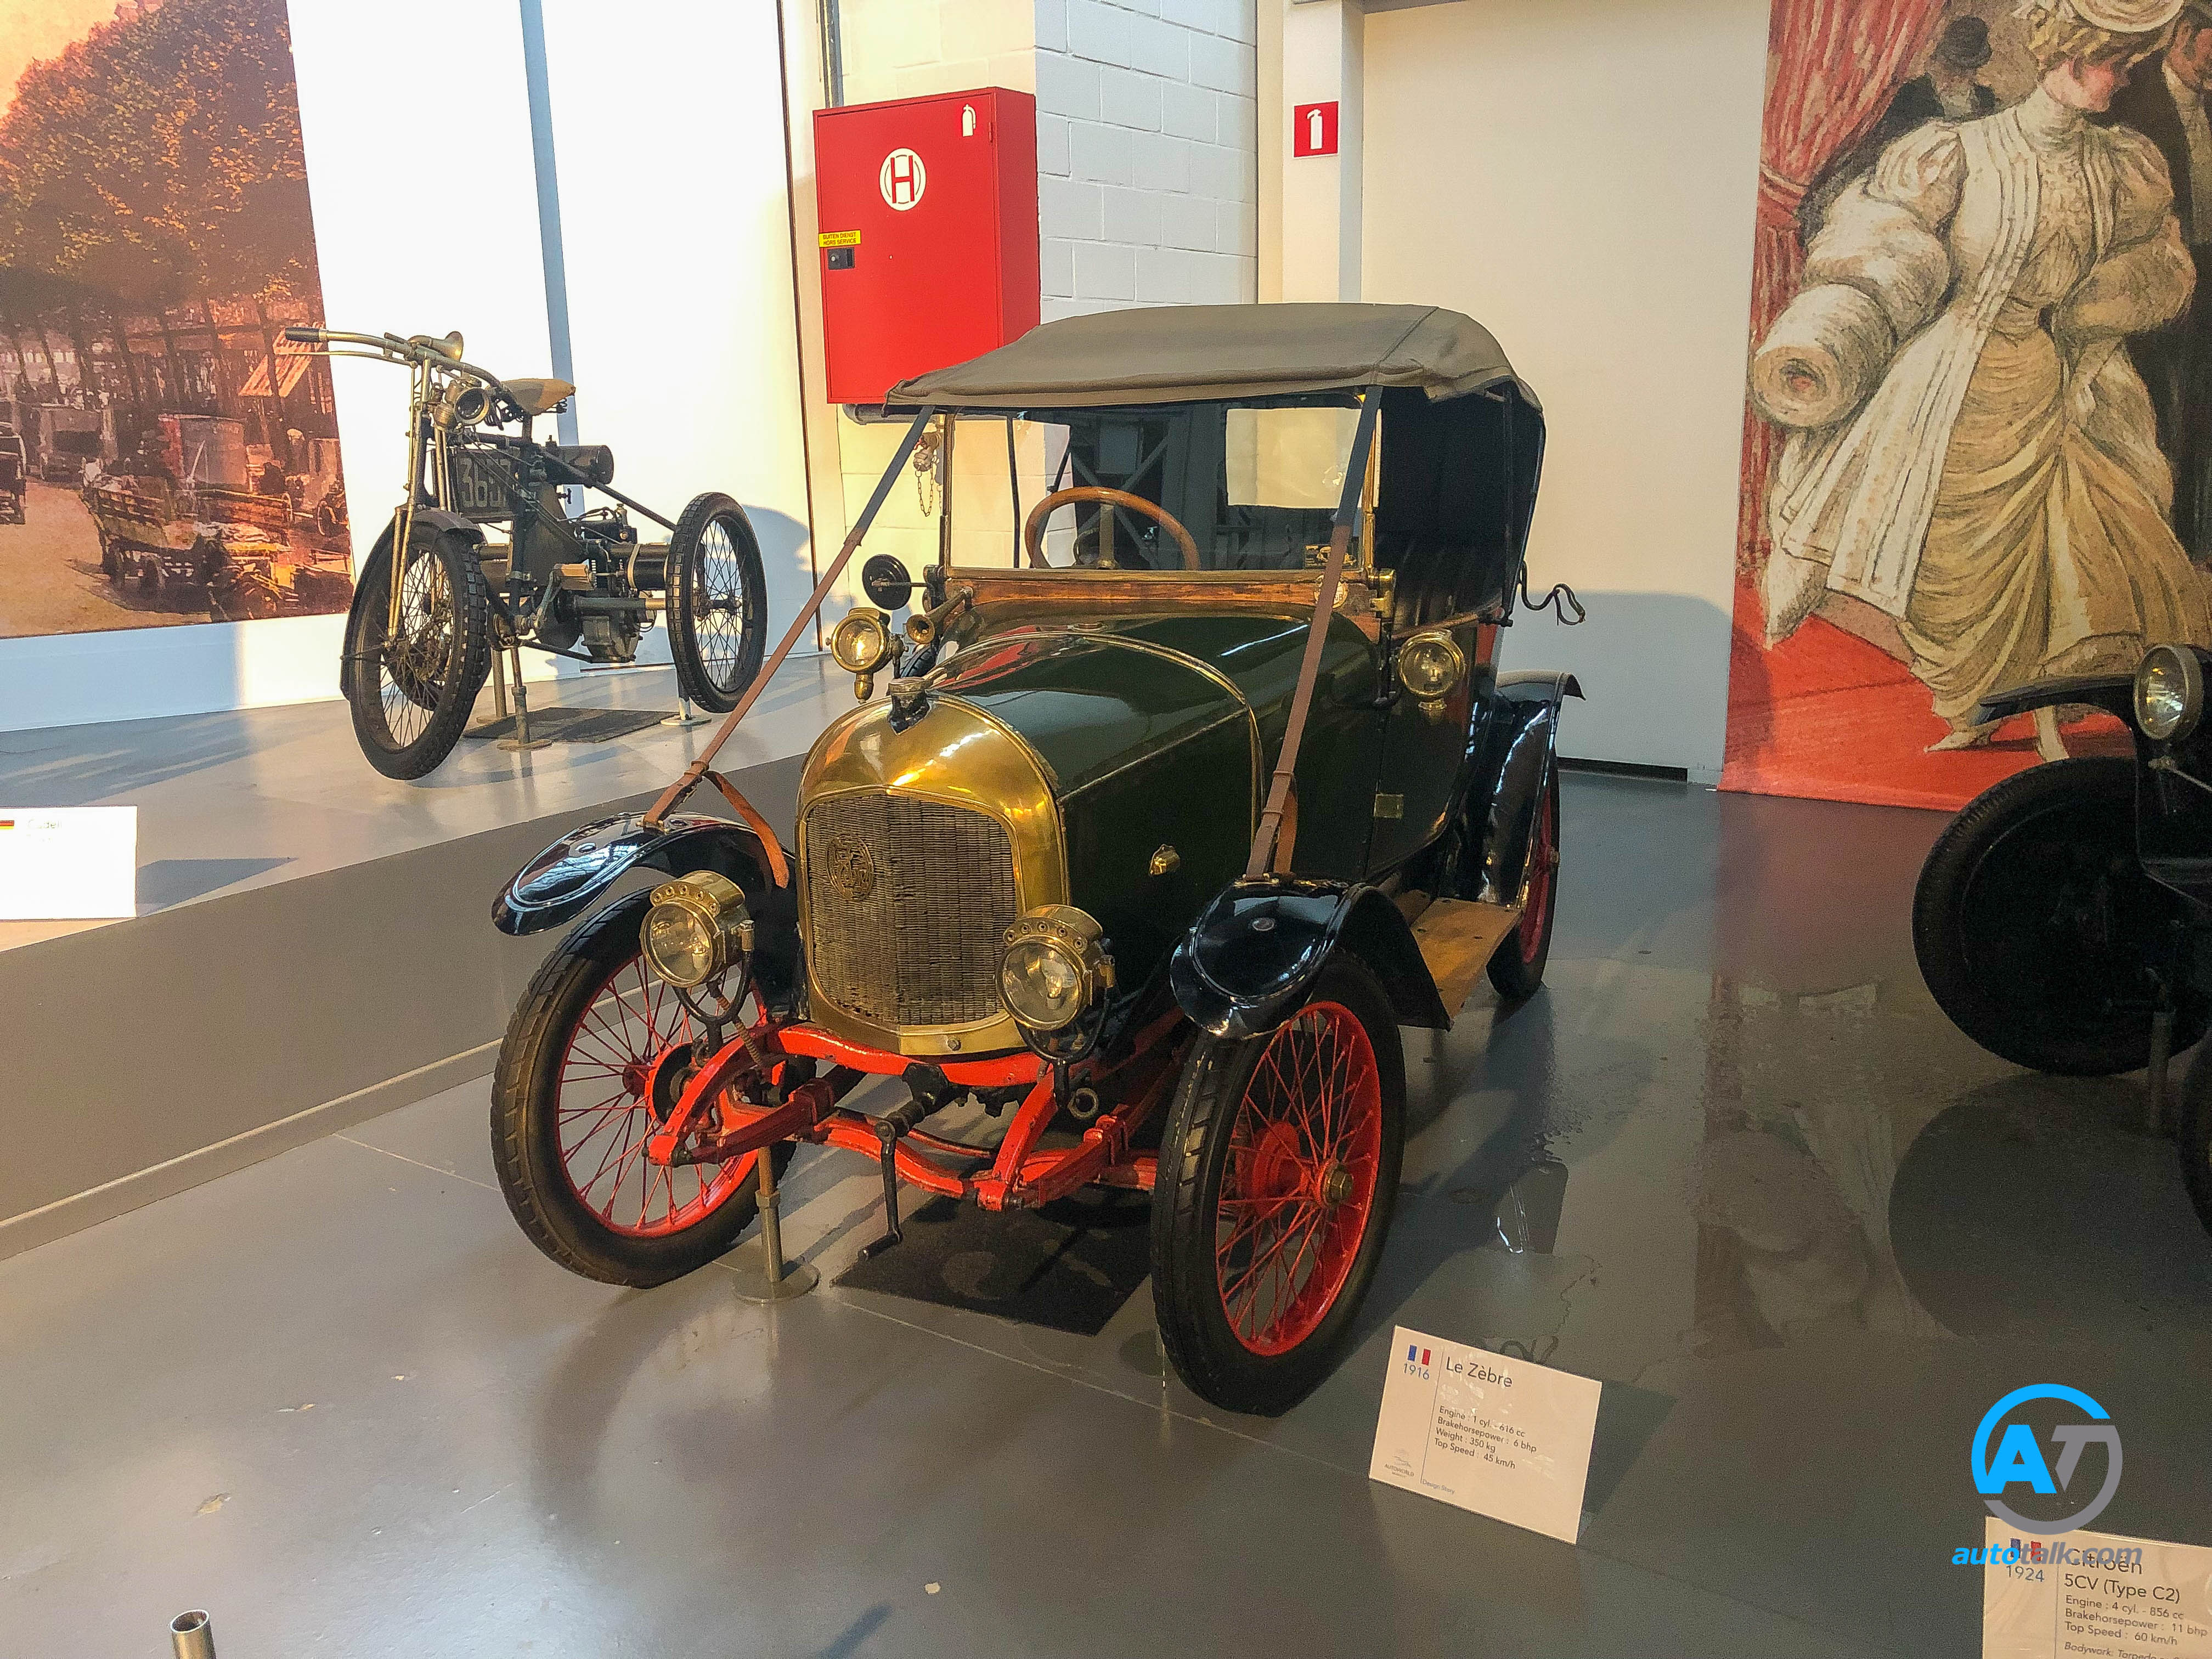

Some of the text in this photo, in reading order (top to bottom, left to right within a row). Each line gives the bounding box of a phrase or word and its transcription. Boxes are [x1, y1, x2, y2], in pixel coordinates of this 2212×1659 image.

[890, 155, 915, 204] H
[1403, 1363, 1430, 1380] 1916
[1446, 1356, 1513, 1387] Le Zèbre
[1439, 1405, 1465, 1420] Engine
[1499, 1424, 1515, 1434] 616
[1436, 1427, 1463, 1442] Weight
[1469, 1437, 1484, 1448] 350
[1486, 1441, 1496, 1453] kg
[1437, 1417, 1505, 1444] Brakehorsepower
[1521, 1441, 1537, 1454] bhp
[1435, 1437, 1448, 1449] Top
[1450, 1443, 1475, 1457] Speed
[1483, 1453, 1494, 1462] 45
[1495, 1456, 1516, 1469] km/h
[2006, 1565, 2045, 1583] 1924
[2064, 1573, 2181, 1604] 5CV (Type C2)
[2066, 1594, 2102, 1609] Engine
[2112, 1602, 2118, 1611] 4
[2150, 1607, 2170, 1618] 856
[2065, 1621, 2084, 1634] Top
[2088, 1625, 2121, 1638] Speed
[2135, 1633, 2148, 1641] 60
[2151, 1634, 2177, 1645] km/h
[2066, 1608, 2159, 1630] Brakehorsepower
[2172, 1623, 2182, 1633] 11
[2187, 1625, 2208, 1638] bhp
